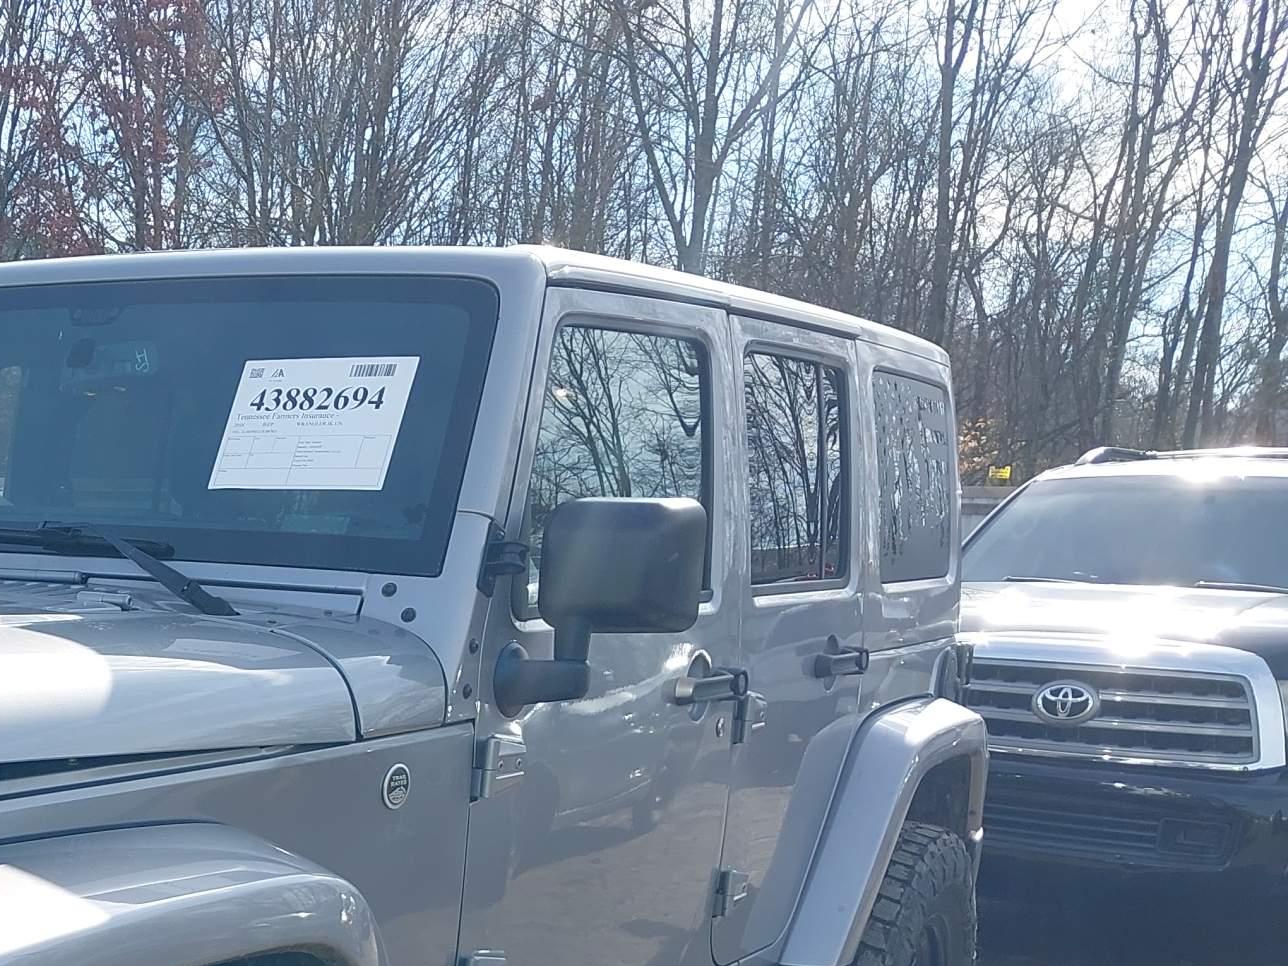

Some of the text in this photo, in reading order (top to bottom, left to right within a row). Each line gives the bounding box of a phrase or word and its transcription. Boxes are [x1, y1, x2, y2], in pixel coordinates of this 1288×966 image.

[249, 386, 385, 412] 43882694
[237, 413, 269, 421] Tennessee
[272, 412, 299, 420] Farmers
